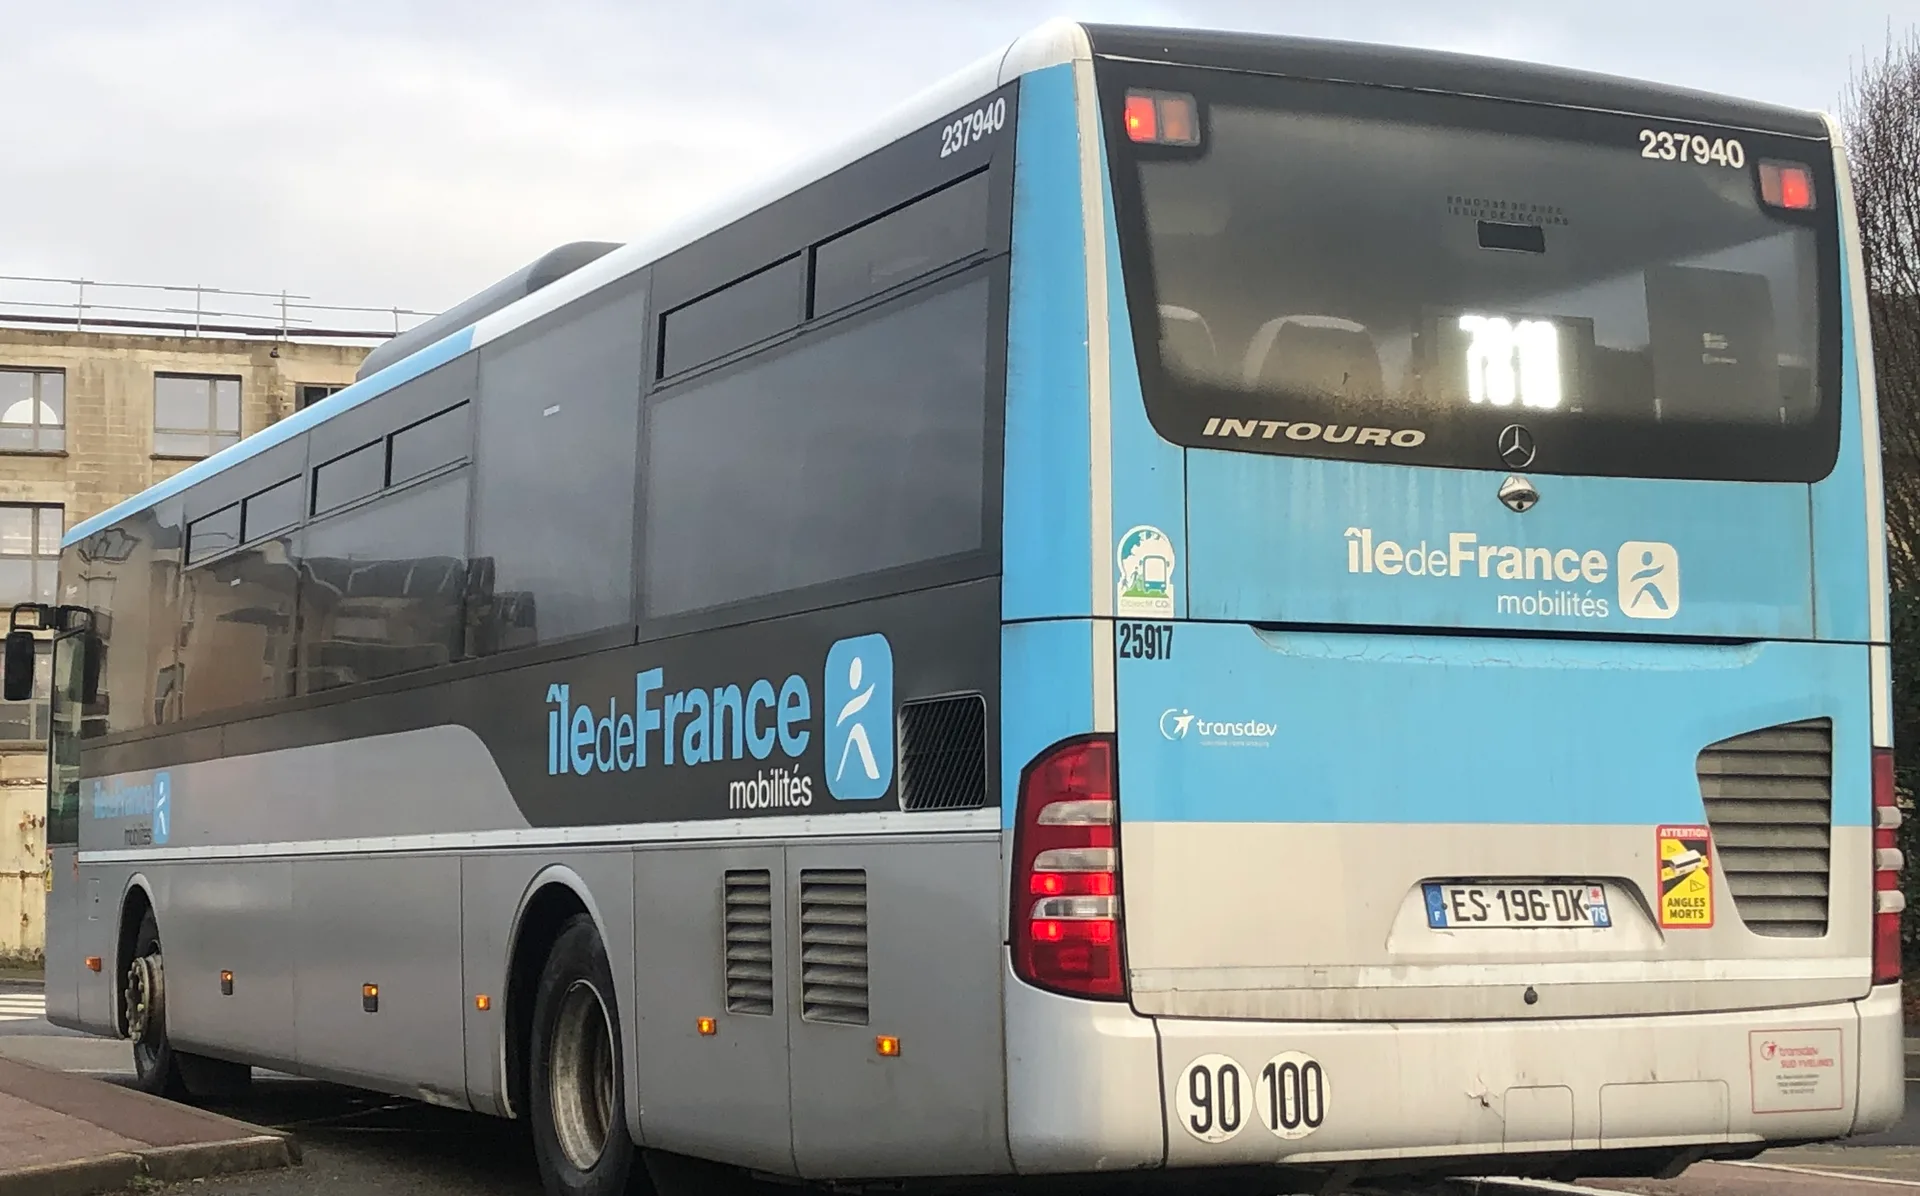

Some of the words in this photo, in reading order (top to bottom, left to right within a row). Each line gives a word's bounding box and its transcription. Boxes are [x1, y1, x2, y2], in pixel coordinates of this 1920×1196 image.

[940, 97, 1006, 159] 237940
[1639, 129, 1745, 169] 237940
[1202, 417, 1426, 448] INTOURO
[1497, 589, 1609, 618] mobilités
[1119, 623, 1173, 660] 25917
[1196, 718, 1277, 736] transdev
[729, 763, 812, 810] mobilités
[1660, 828, 1708, 837] ATTENTION
[1434, 911, 1441, 921] F
[1591, 907, 1608, 922] 78
[1667, 897, 1706, 907] ANGLES
[1669, 909, 1705, 919] MORTS
[1189, 1063, 1241, 1134] 90
[1262, 1060, 1324, 1131] 100
